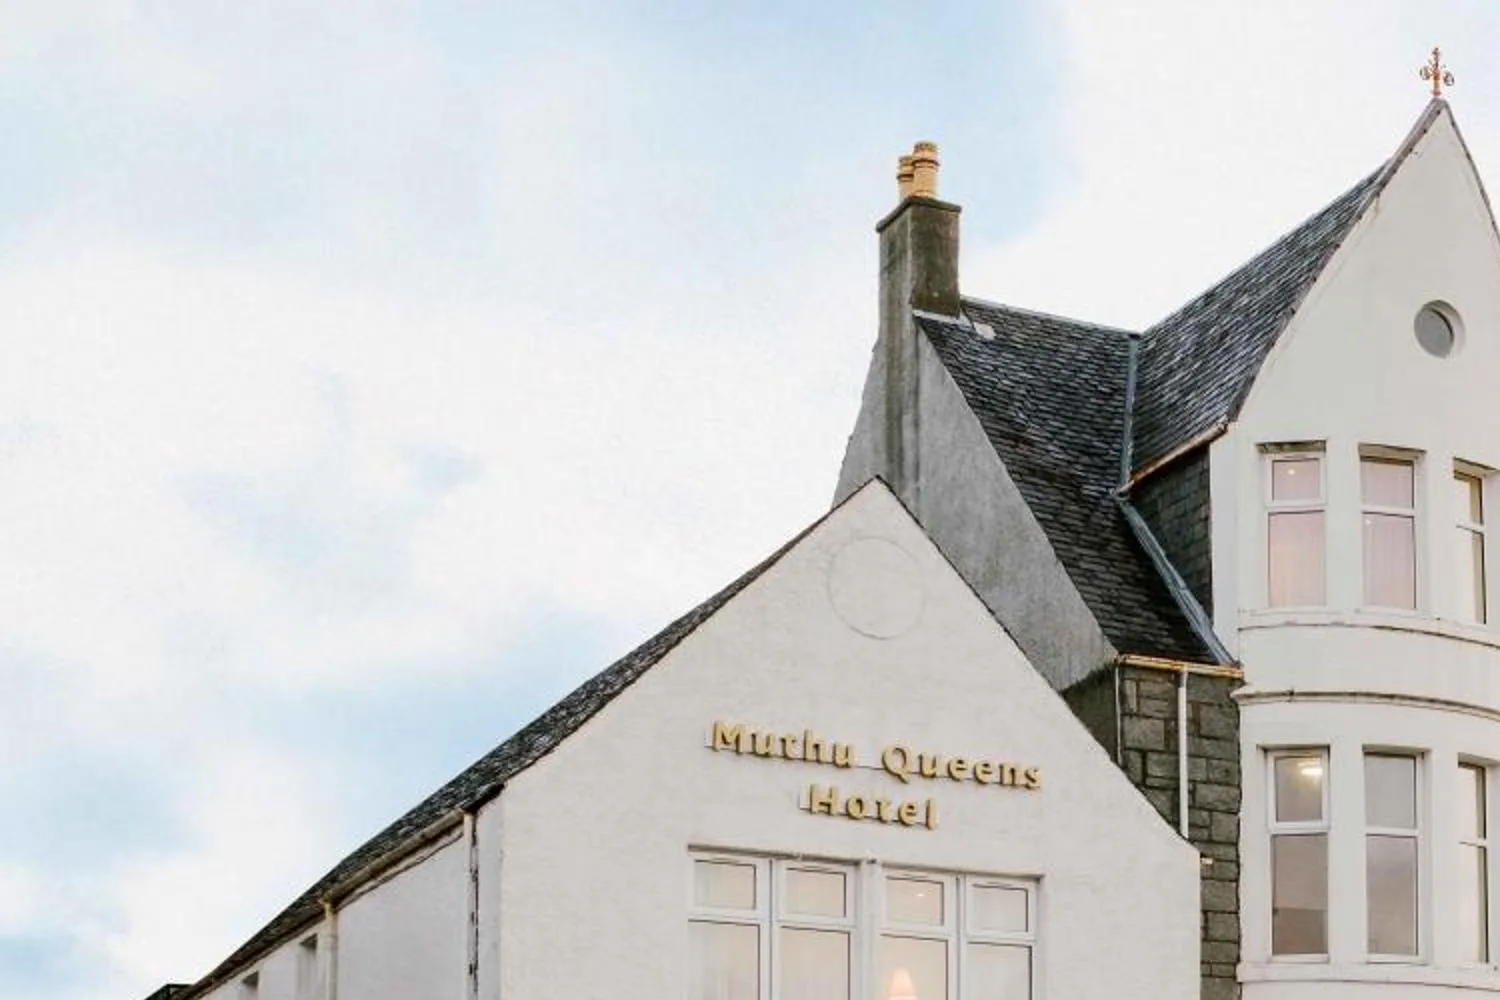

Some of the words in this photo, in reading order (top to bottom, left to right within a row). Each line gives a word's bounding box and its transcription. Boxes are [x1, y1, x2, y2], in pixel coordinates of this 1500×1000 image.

[712, 721, 855, 769] Muthu
[881, 747, 1042, 789] Queens
[809, 784, 938, 830] Hotel
